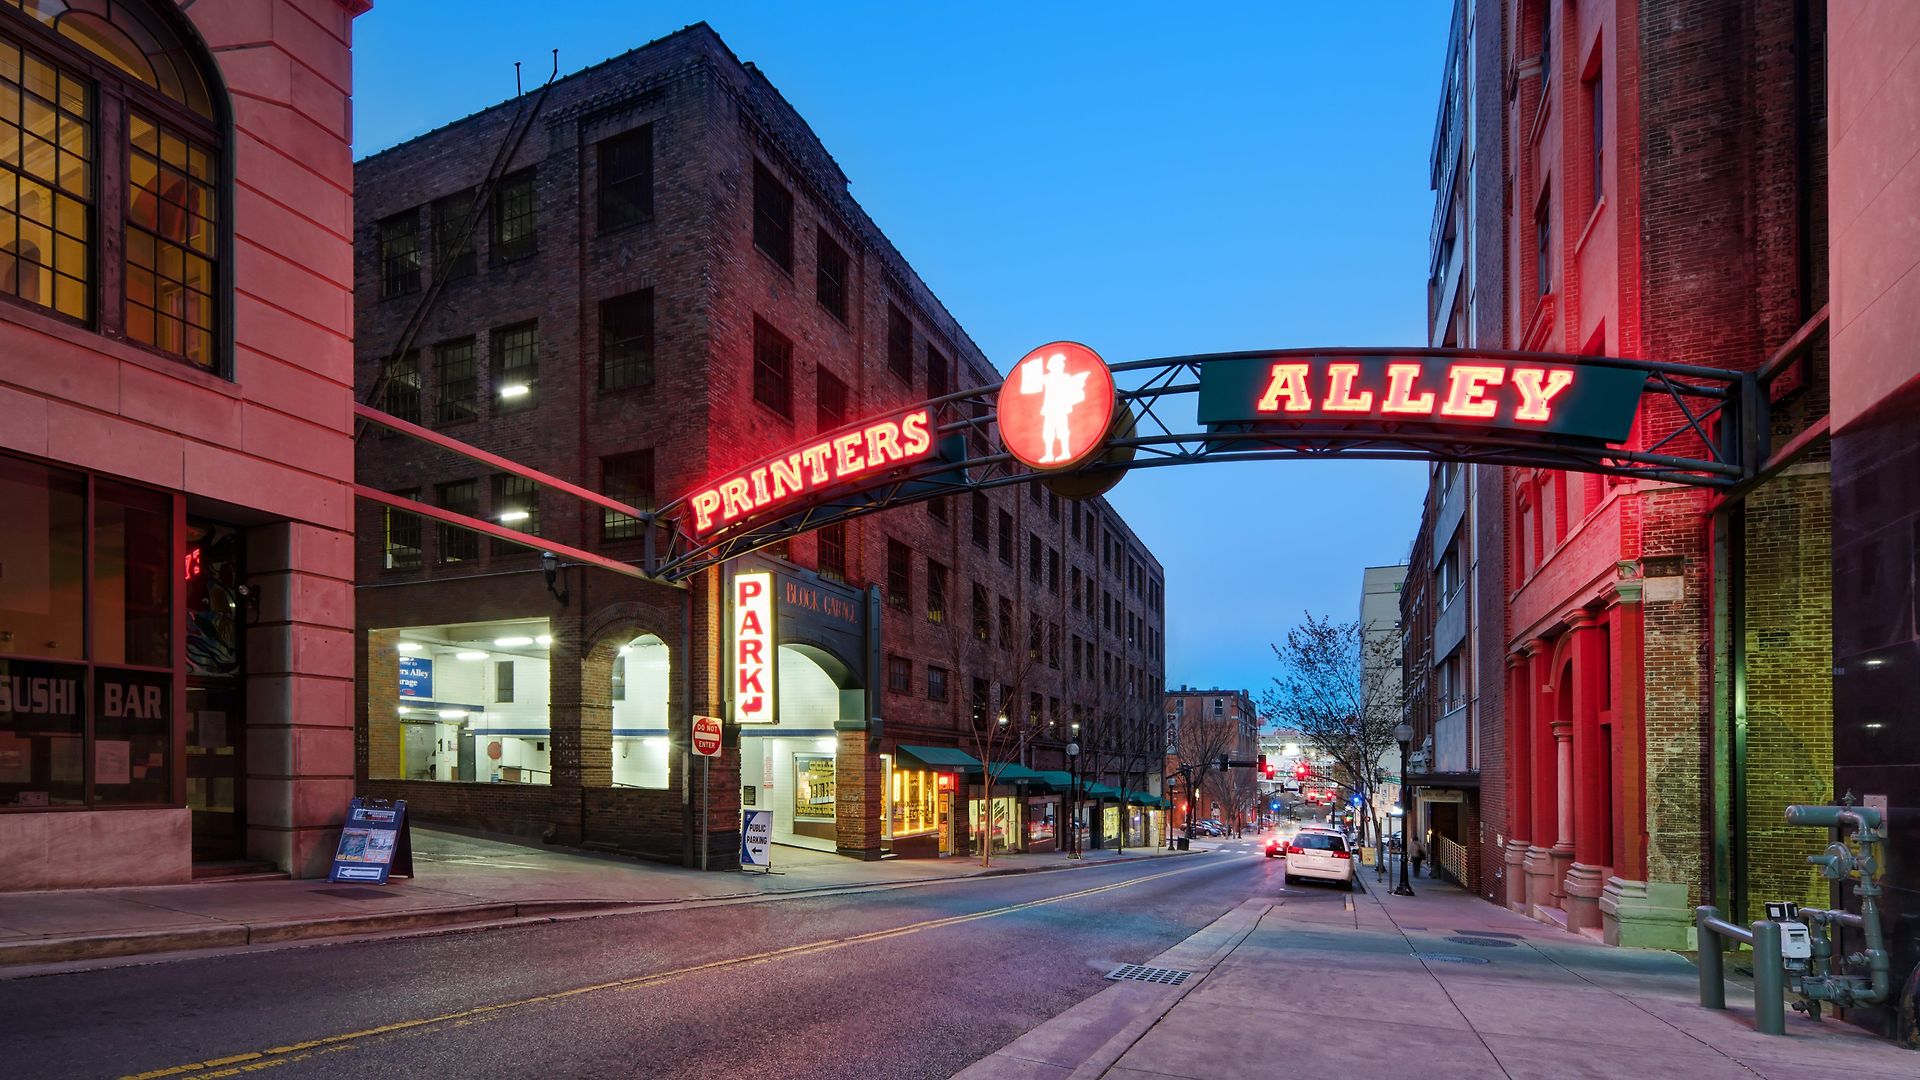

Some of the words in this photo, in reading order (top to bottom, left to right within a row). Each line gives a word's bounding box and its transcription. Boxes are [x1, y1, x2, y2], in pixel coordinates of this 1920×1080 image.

[1257, 363, 1574, 422] ALLEY
[691, 411, 930, 531] PRINTERS
[786, 582, 819, 612] BLOCK
[739, 580, 764, 694] PARK
[410, 668, 429, 679] Alley
[0, 674, 76, 715] SUSHI
[104, 682, 161, 719] BAR
[697, 723, 705, 731] DO
[698, 740, 716, 749] ENTER
[749, 823, 766, 833] PUBLIC
[746, 835, 767, 845] PARKING
